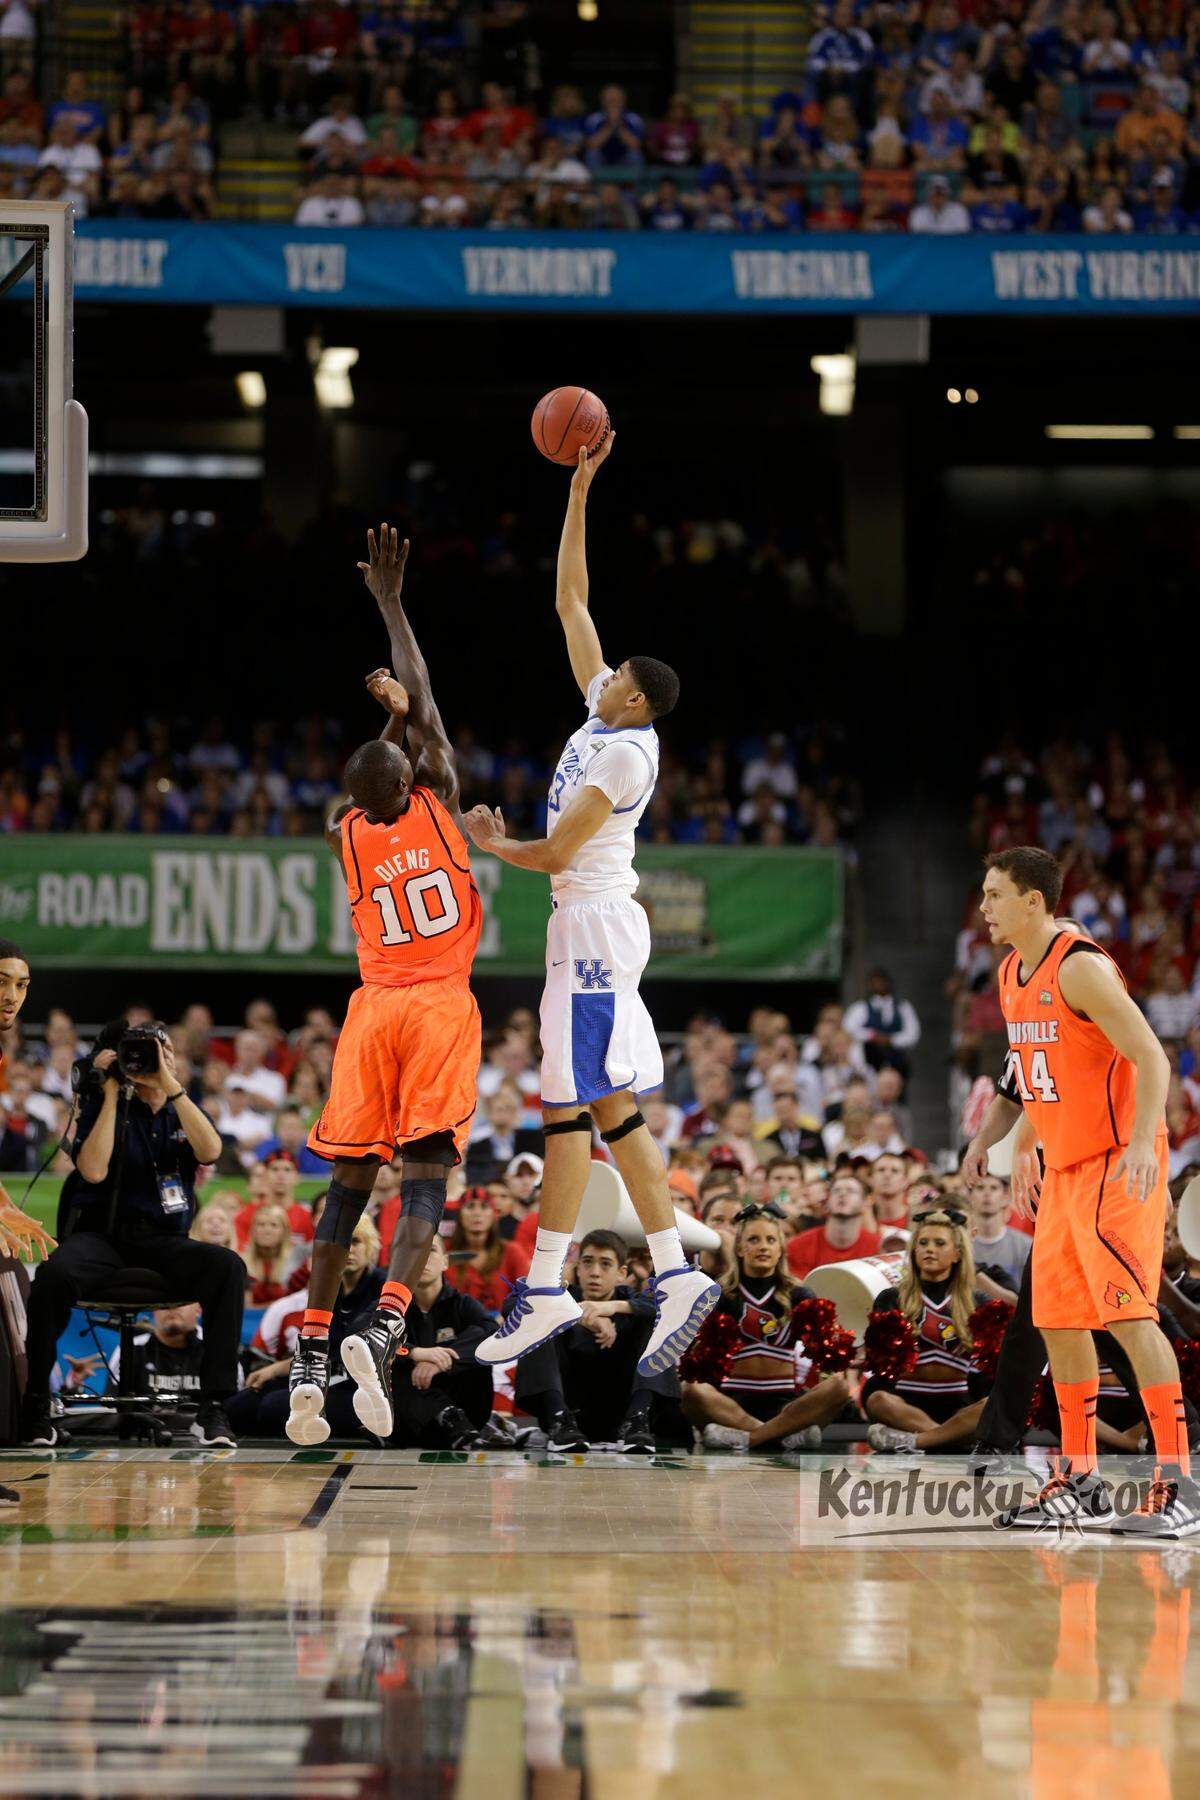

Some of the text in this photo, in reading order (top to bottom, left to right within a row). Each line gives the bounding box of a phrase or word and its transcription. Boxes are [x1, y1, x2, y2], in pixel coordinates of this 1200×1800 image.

[283, 242, 346, 293] VCU
[461, 246, 617, 297] VERMONT
[731, 249, 874, 300] VIRGINIA
[991, 250, 1083, 300] WEST
[373, 847, 430, 883] DIENG
[37, 871, 150, 929] ROAD
[151, 851, 318, 954] ENDS
[370, 866, 461, 947] 10
[574, 958, 613, 989] UK
[1010, 1048, 1061, 1103] 14
